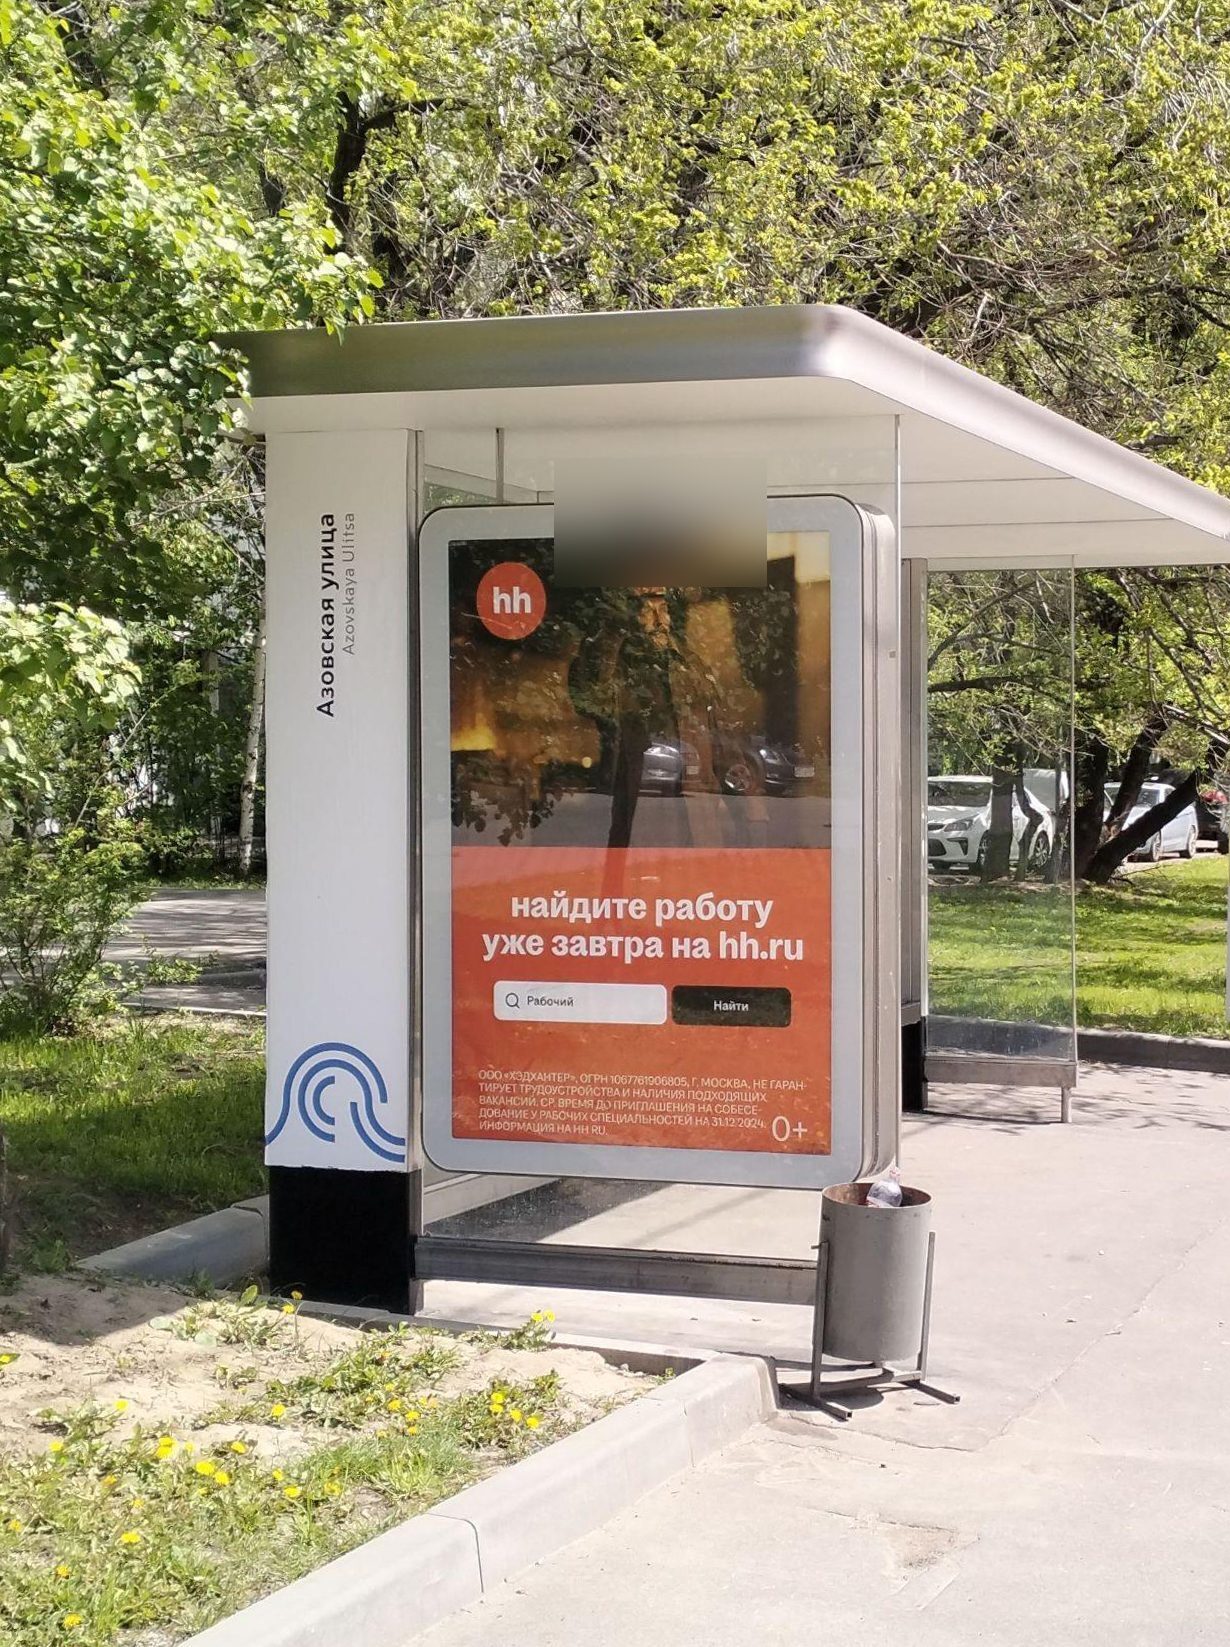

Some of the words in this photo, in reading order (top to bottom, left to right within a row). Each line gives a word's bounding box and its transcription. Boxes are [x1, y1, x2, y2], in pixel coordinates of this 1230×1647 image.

[341, 513, 356, 563] Ulitsa
[320, 514, 340, 591] улица
[341, 568, 358, 656] Azovskaya
[492, 586, 532, 615] hh
[316, 598, 335, 718] Азовская
[511, 891, 647, 923] найдите
[655, 892, 774, 929] работу
[481, 933, 544, 962] уже
[551, 935, 664, 964] завтра
[672, 938, 711, 960] на
[719, 931, 804, 961] hh.ru
[526, 995, 575, 1008] Рабочий
[713, 999, 750, 1012] Найти
[478, 1070, 503, 1080] ООО
[580, 1073, 608, 1084] ОГРН
[753, 1079, 767, 1089] НЕ
[769, 1080, 807, 1091] ГАРАН-
[479, 1083, 517, 1093] ТИРУЕТ
[520, 1083, 620, 1098] ТРУДОУСТРОЙСТВА
[623, 1087, 630, 1097] И
[633, 1088, 686, 1099] НАЛИЧИЯ
[688, 1090, 768, 1103] ПОДХОДЯЩИХ
[478, 1107, 529, 1120] ДОВАНИЕ
[531, 1109, 538, 1119] У
[539, 1110, 587, 1122] РАБОЧИХ
[589, 1111, 693, 1126] СПЕЦИАЛЬНОСТЕЙ
[695, 1116, 710, 1127] НА
[558, 1098, 594, 1109] ВРЕМЯ
[596, 1099, 612, 1111] ДО
[613, 1100, 696, 1112] ПРИГЛАШЕНИЯ
[698, 1103, 712, 1113] НА
[715, 1103, 763, 1115] СОБЕСЕ-
[479, 1120, 555, 1135] ИНФОРМАЦИЯ
[557, 1123, 571, 1133] НА
[772, 1115, 808, 1142] 0+
